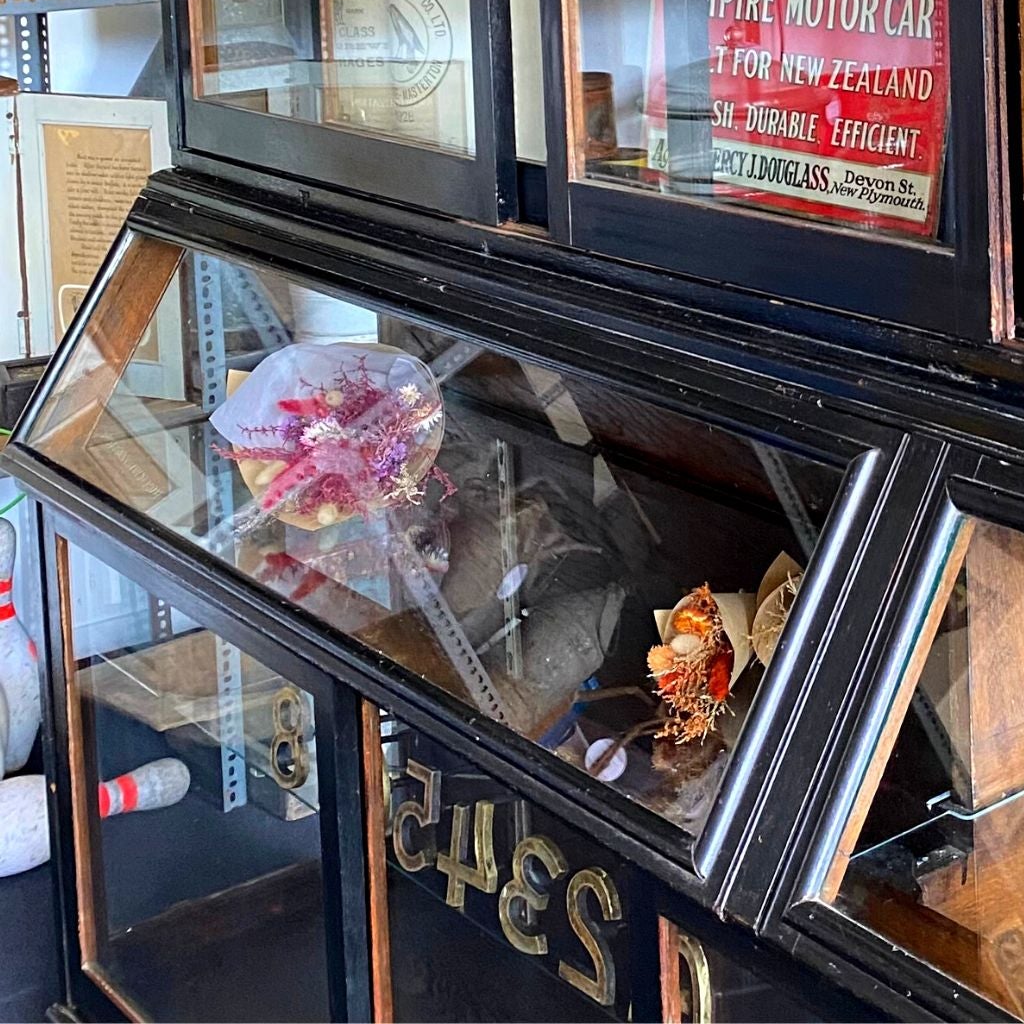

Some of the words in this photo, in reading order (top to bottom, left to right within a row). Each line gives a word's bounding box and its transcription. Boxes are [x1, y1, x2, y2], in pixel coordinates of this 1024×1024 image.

[733, 48, 772, 81] FOR
[780, 52, 825, 87] NEW
[828, 59, 934, 102] ZEALAND
[831, 117, 924, 160] EFFICIENT.
[830, 181, 859, 197] New
[858, 187, 926, 211] Plymouth.
[844, 170, 895, 192] Devon
